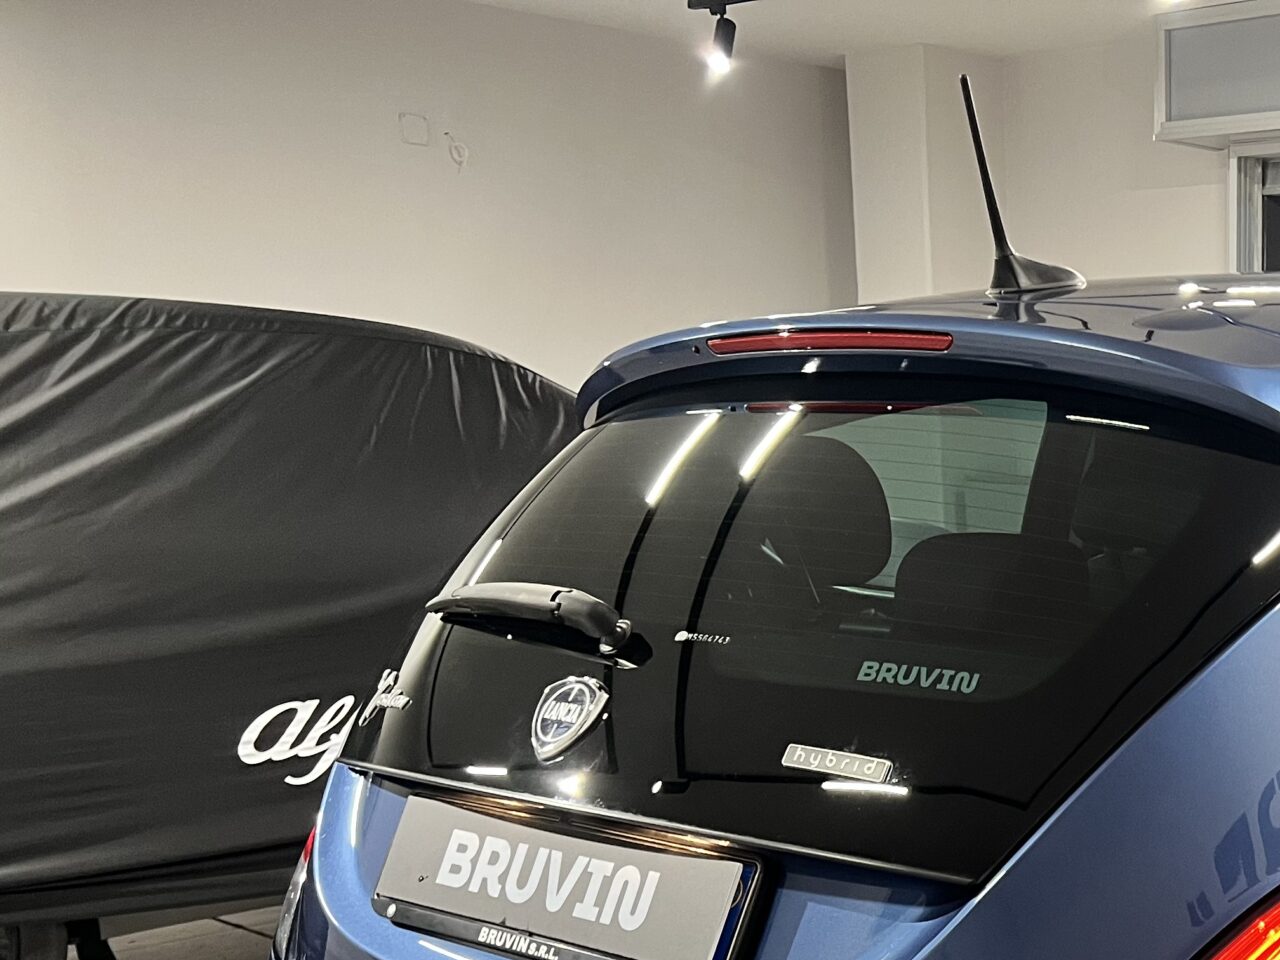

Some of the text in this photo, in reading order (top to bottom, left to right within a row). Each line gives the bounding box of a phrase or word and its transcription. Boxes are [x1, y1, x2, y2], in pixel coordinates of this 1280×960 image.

[856, 661, 980, 694] BRUVIN
[543, 700, 582, 724] LANCIA
[792, 747, 879, 776] hybrid
[434, 828, 661, 932] BRUVIN
[478, 926, 530, 954] BRUVIN
